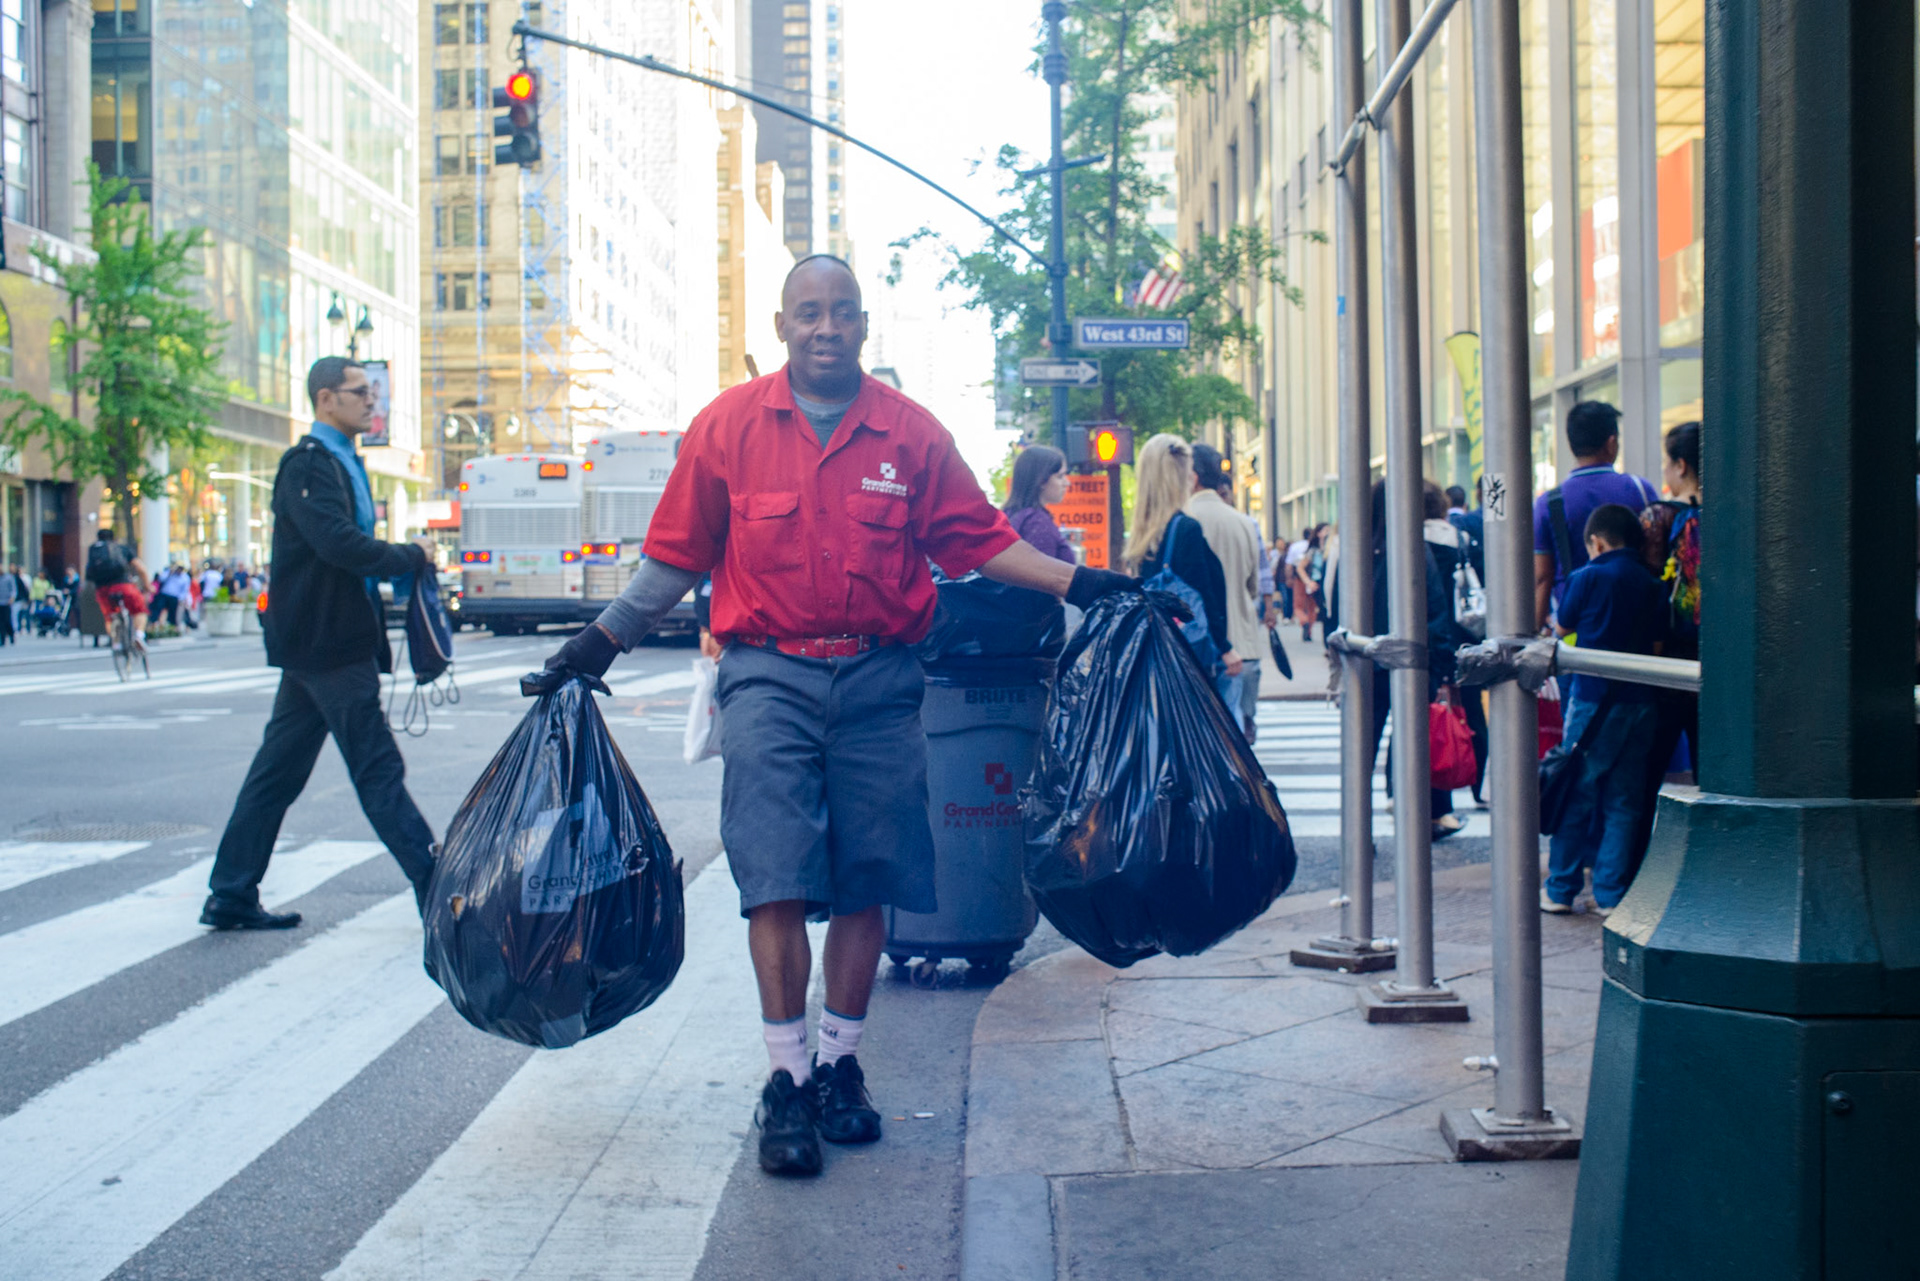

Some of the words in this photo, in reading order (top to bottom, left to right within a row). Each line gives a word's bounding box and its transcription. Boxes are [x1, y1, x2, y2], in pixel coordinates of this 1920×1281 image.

[1084, 325, 1125, 342] West
[1127, 326, 1163, 342] 43rd
[1165, 325, 1183, 342] St
[1068, 481, 1105, 493] STREET
[1059, 512, 1104, 525] CLOSED
[965, 688, 1027, 704] BRUTE
[943, 801, 996, 817] Grand
